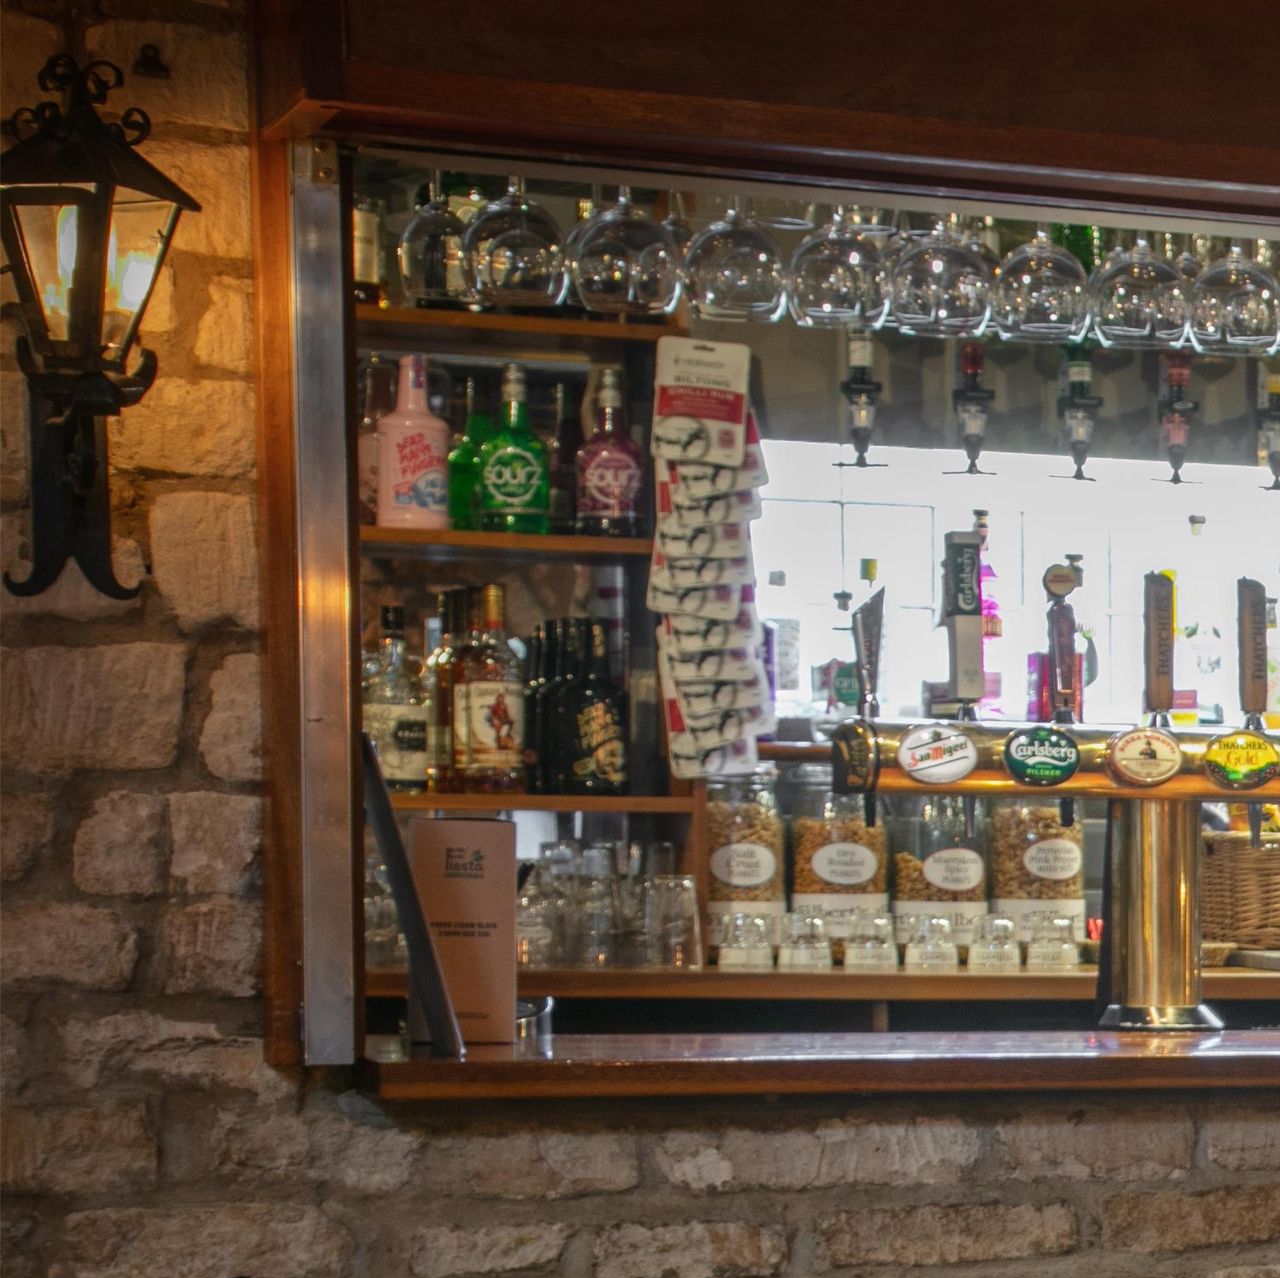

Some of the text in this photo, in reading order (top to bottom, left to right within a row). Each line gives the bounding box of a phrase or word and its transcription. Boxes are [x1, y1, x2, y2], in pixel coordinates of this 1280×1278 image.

[484, 464, 543, 485] sourz
[957, 548, 975, 611] Carlsberg
[907, 740, 968, 768] San Miguel
[1009, 737, 1078, 762] Carlsberg
[1218, 740, 1268, 751] THATCHERS
[1226, 750, 1258, 767] Gold
[1025, 768, 1062, 776] PILSNER
